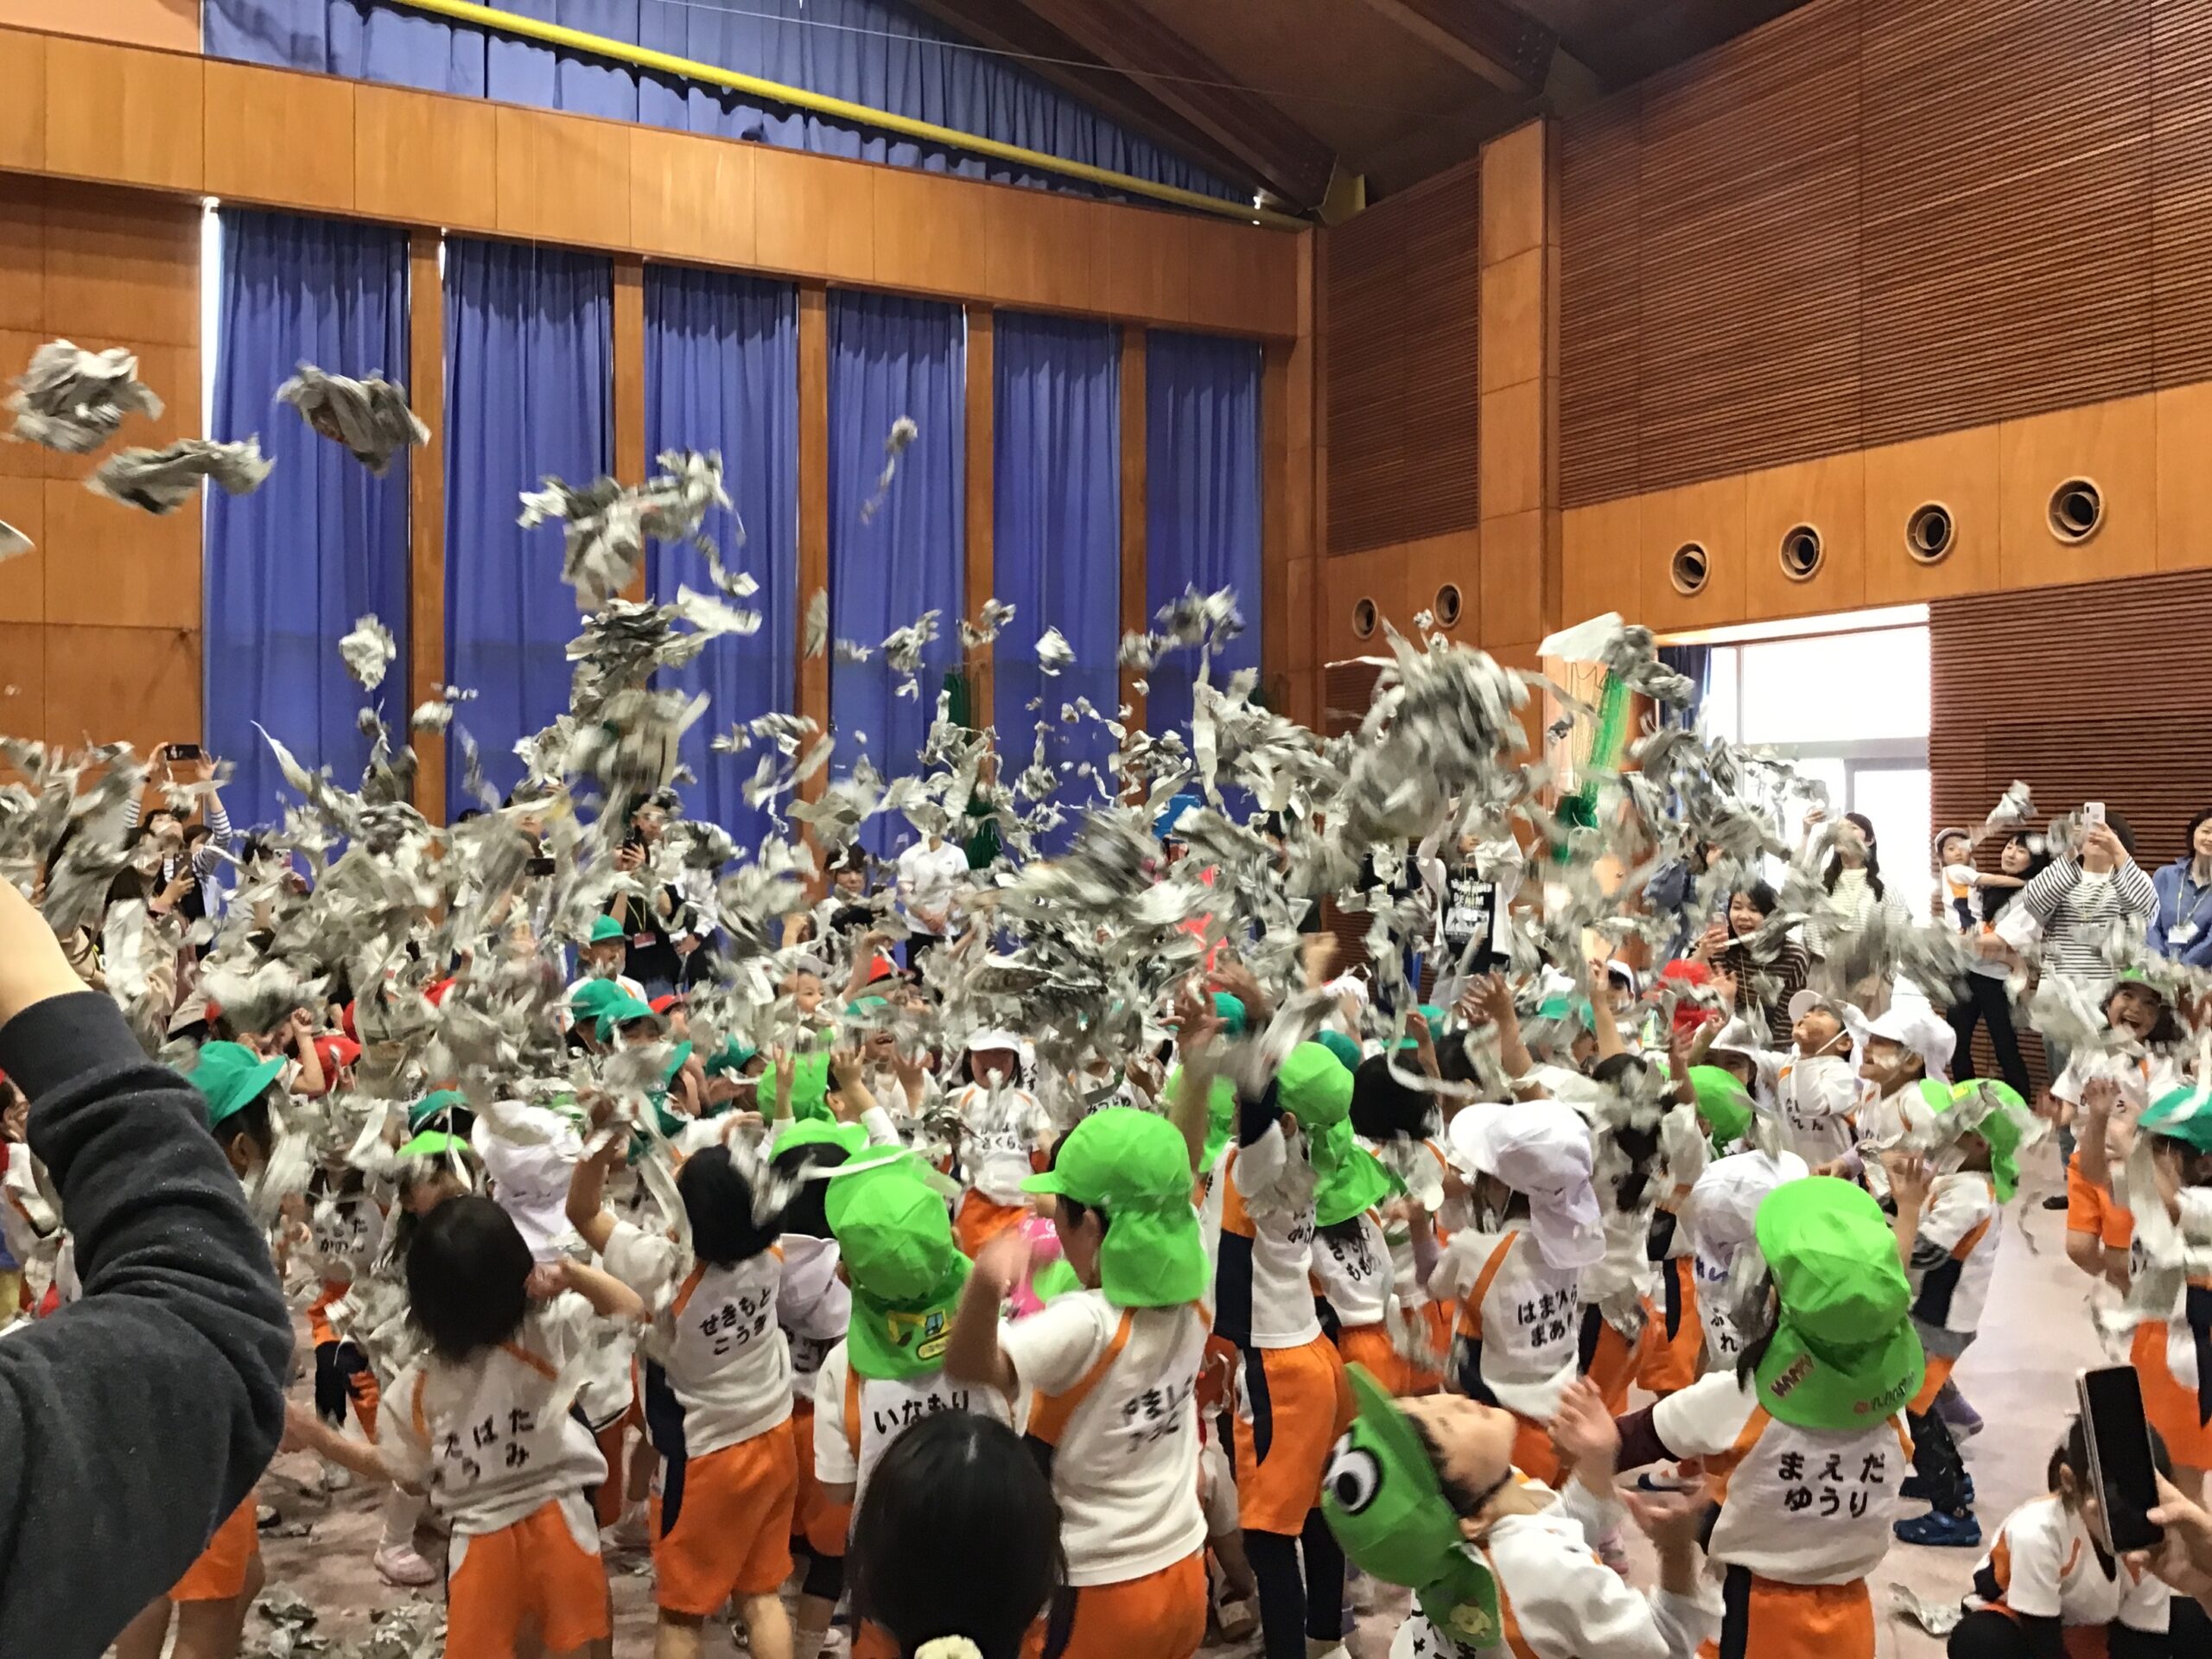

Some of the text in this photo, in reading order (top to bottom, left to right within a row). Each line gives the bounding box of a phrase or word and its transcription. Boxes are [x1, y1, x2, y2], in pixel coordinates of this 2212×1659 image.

[699, 1287, 771, 1337] せきもと
[1778, 1452, 1885, 1484] まえだ
[1783, 1485, 1868, 1519] ゆうり
